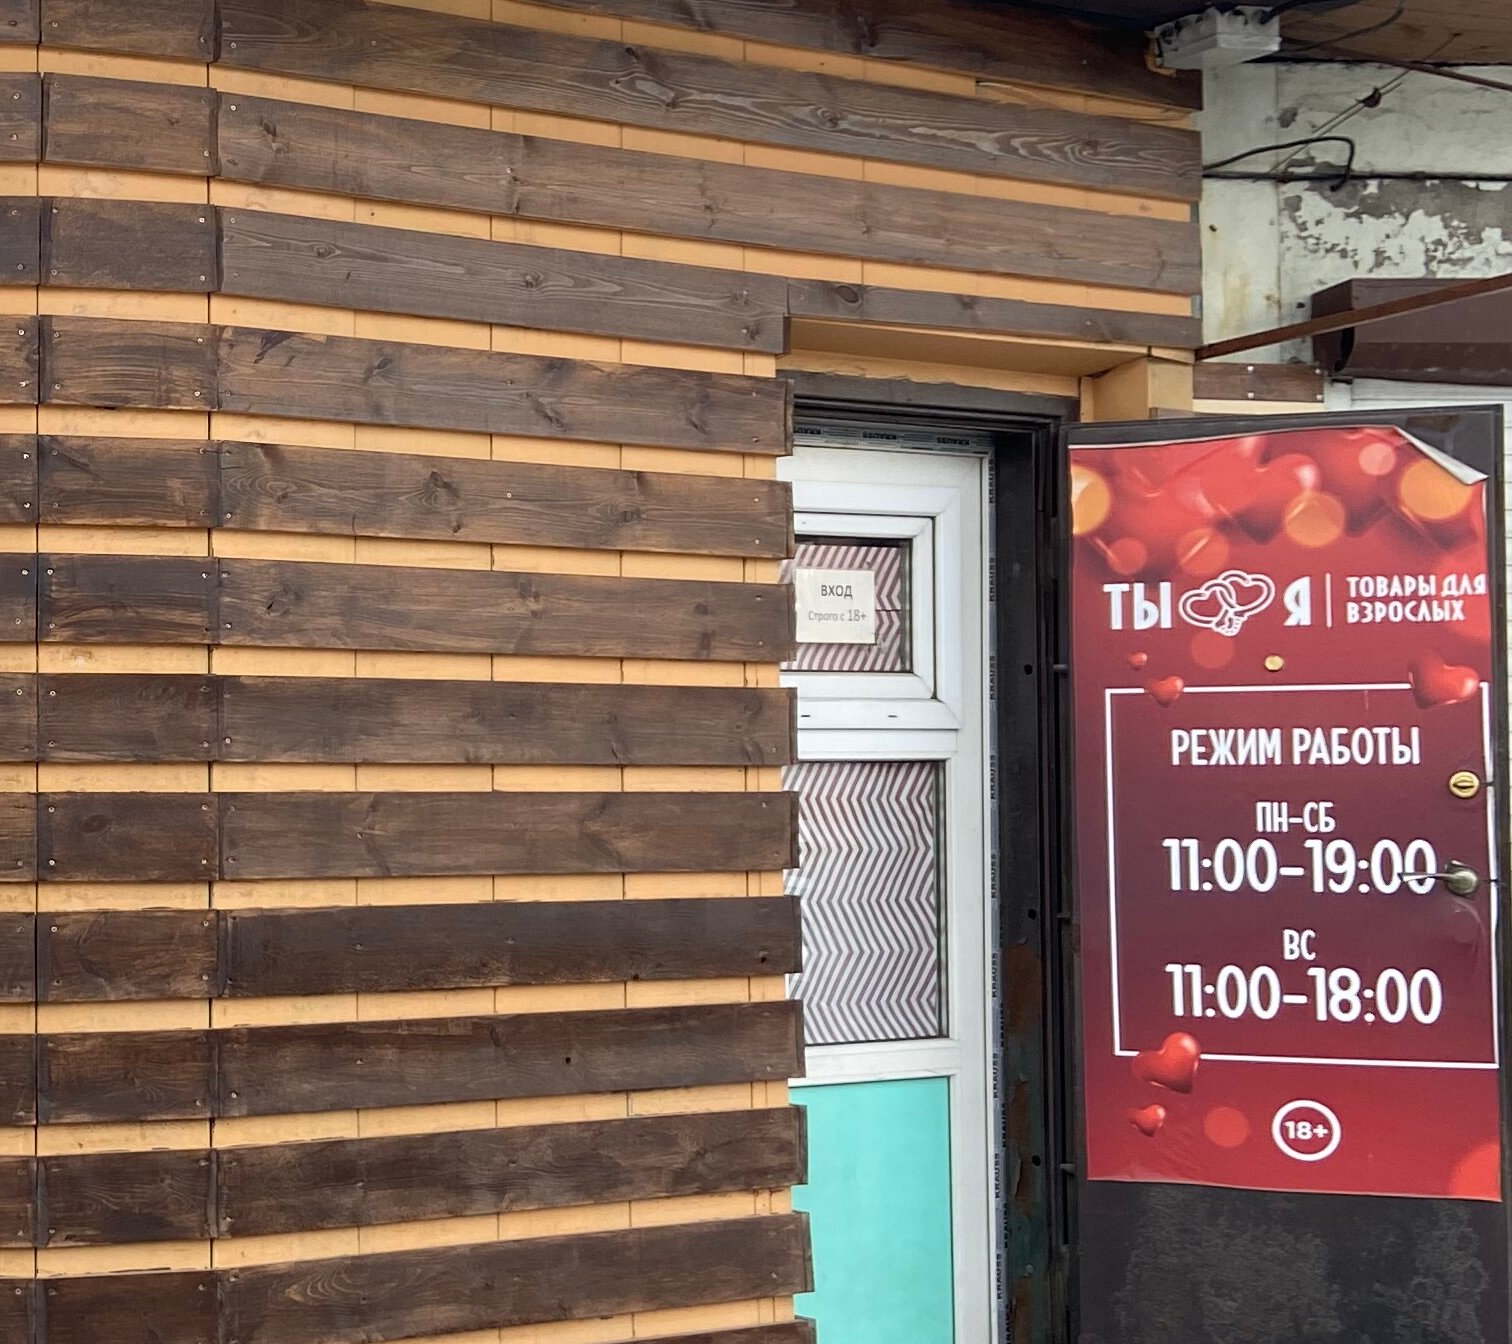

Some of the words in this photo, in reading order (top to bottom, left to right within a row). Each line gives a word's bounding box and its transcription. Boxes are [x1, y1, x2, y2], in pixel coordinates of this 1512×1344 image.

[820, 584, 853, 599] ВХОД
[1346, 574, 1436, 598] ТОВАРЫ
[1440, 573, 1487, 598] ДЛЯ
[808, 610, 838, 623] Строго
[848, 609, 867, 622] 18+
[1103, 582, 1172, 630] ТЫ
[1283, 576, 1311, 626] Я
[1346, 600, 1465, 624] ВЗРОСЛЫХ
[1171, 728, 1281, 765] РЕЖИМ
[1292, 726, 1420, 765] РАБОТЫ
[1256, 801, 1336, 833] ПН-СБ
[1161, 838, 1437, 895] 11:00-19:00
[1283, 929, 1317, 961] ВС
[1164, 963, 1443, 1024] 11:00-18:00
[1284, 1120, 1329, 1140] 18+
